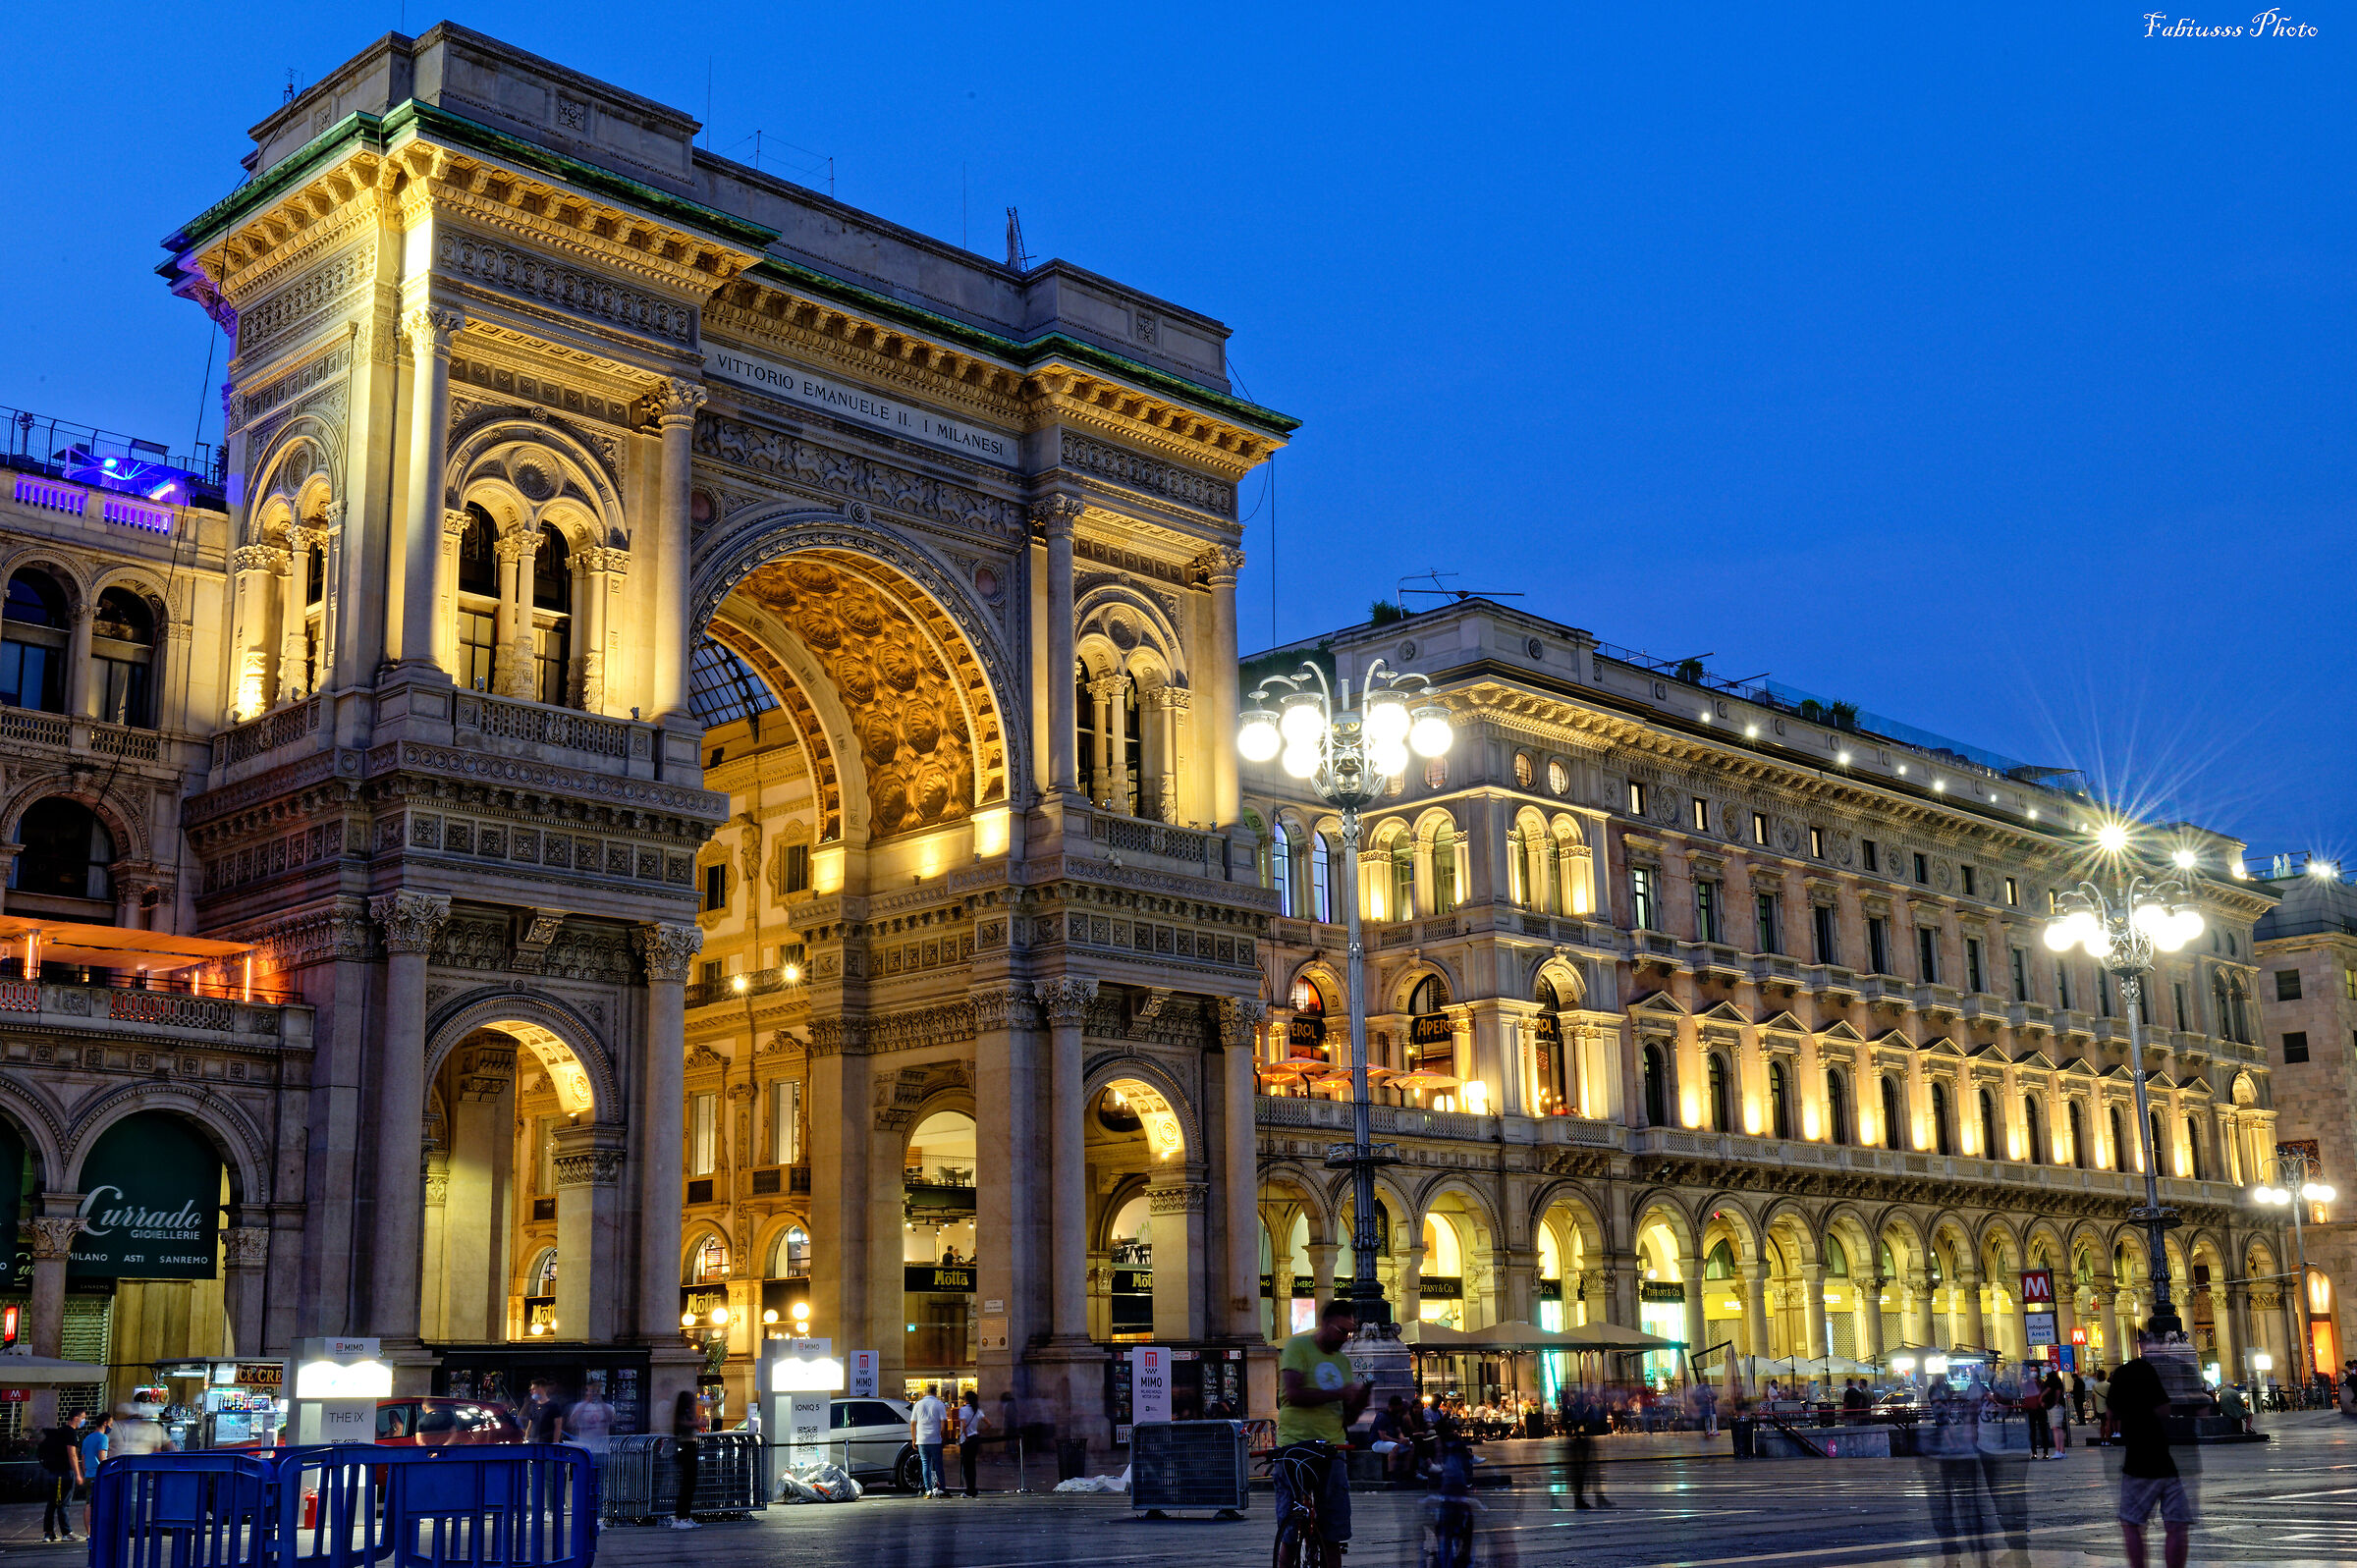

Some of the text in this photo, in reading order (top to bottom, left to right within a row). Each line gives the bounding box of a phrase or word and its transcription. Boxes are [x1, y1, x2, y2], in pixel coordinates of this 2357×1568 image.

[717, 353, 795, 390] VITTORIO
[803, 381, 890, 420] EMANUELE
[924, 419, 929, 433] I
[937, 423, 1004, 457] MILANESI
[78, 1185, 202, 1237] Currado
[130, 1229, 200, 1241] GIOIELLERIE
[68, 1252, 208, 1265] MILANO ASTI SANREMO
[934, 1270, 968, 1286] Motta
[2024, 1276, 2050, 1297] M
[686, 1292, 722, 1314] Motta
[5, 1314, 15, 1335] M
[2072, 1330, 2086, 1342] M
[344, 1343, 364, 1352] MIMO
[855, 1378, 872, 1387] MIMO
[1140, 1377, 1163, 1388] MIMO
[10, 1389, 21, 1398] M
[329, 1412, 352, 1423] THE
